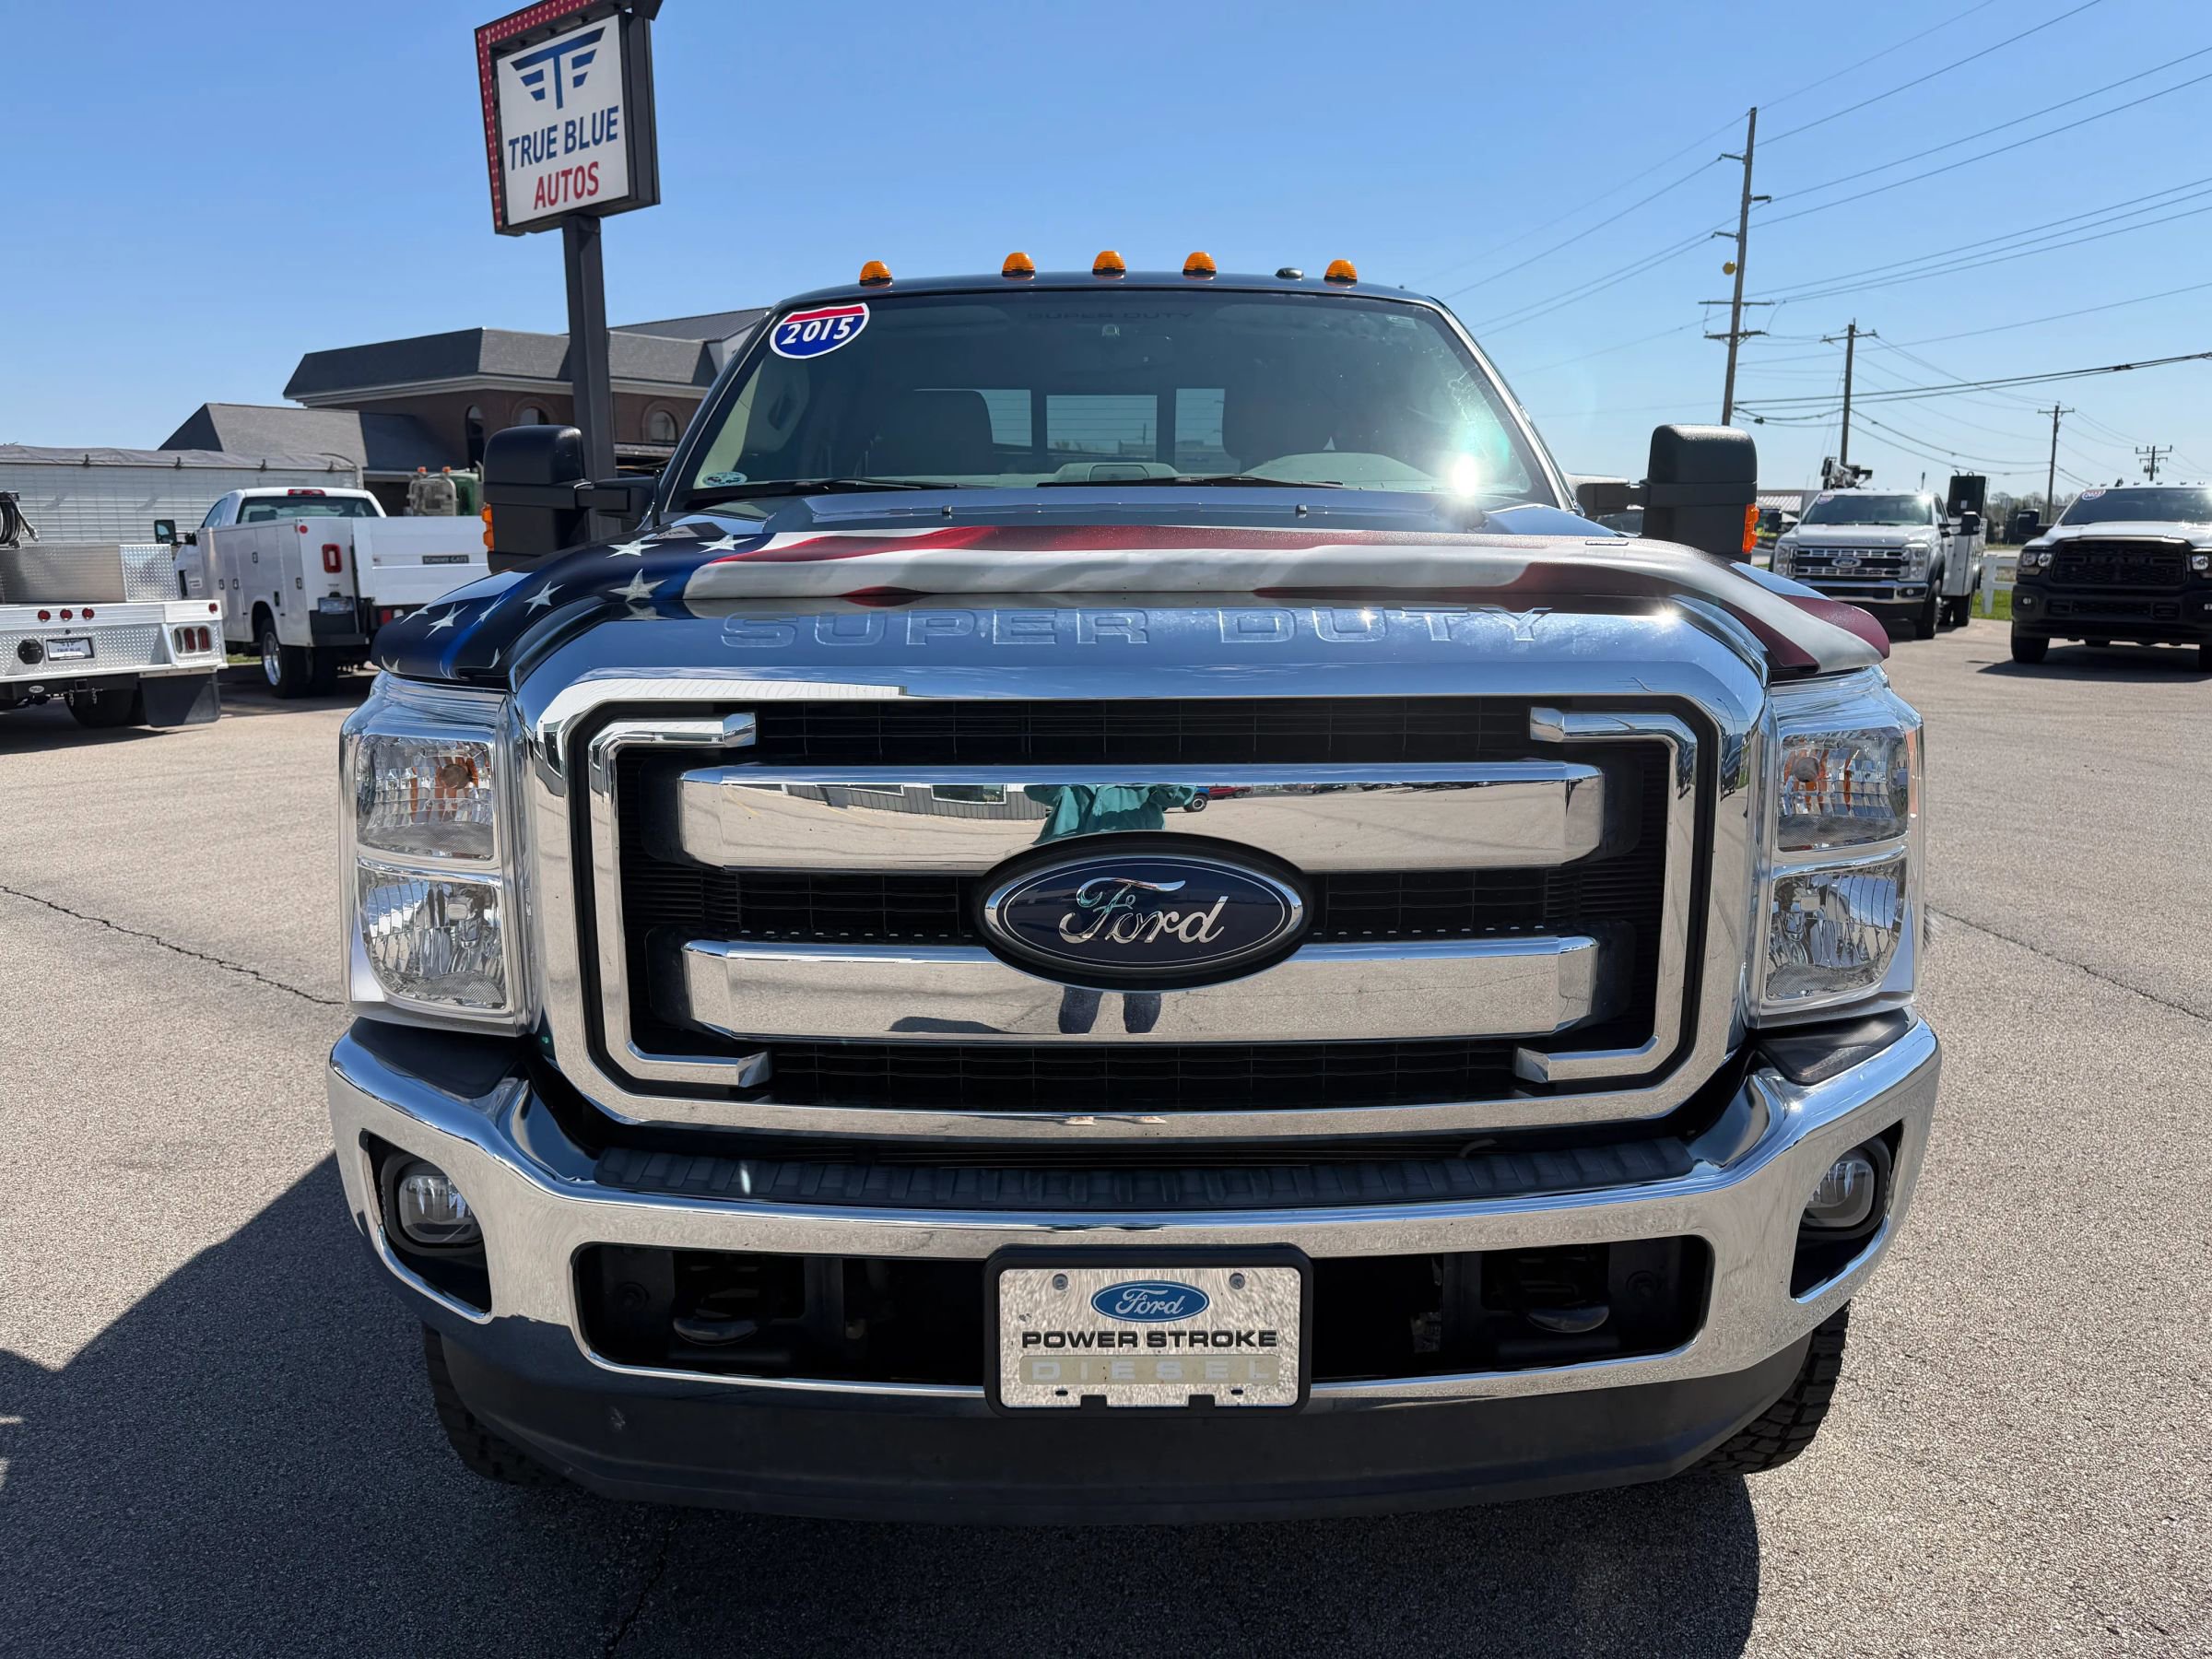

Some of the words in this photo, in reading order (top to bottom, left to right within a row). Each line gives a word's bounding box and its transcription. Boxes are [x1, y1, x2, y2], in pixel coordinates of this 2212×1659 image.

[509, 124, 558, 171] TRUE
[564, 105, 618, 155] BLUE
[534, 161, 599, 210] AUTOS
[781, 316, 855, 346] 2015
[721, 607, 1150, 648] SUPER
[1218, 606, 1554, 643] DUTY
[1058, 877, 1230, 945] Ford
[1114, 1288, 1185, 1316] Ford
[1021, 1330, 1138, 1348] POWER
[1146, 1329, 1277, 1348] STROKE
[1031, 1360, 1270, 1381] DIESEL
